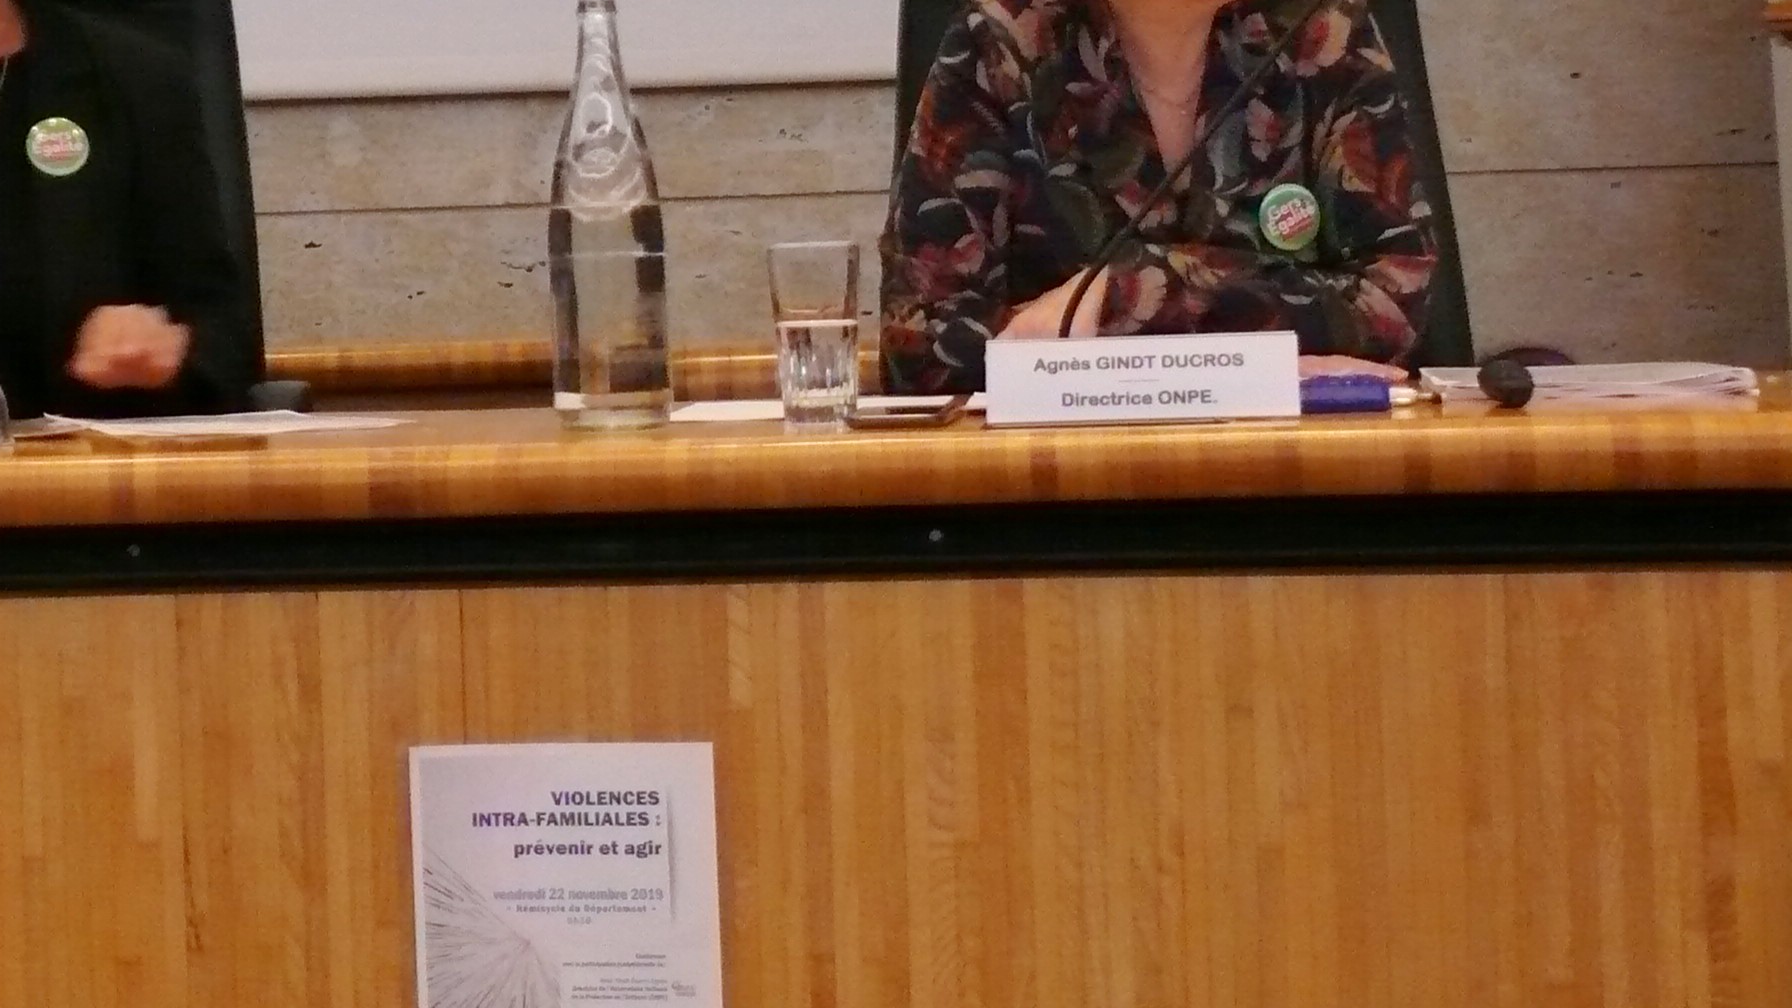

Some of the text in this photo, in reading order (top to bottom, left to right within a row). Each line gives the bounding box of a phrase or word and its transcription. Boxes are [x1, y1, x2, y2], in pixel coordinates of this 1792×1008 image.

[1033, 353, 1244, 374] Agnès GINDT DUCROS
[1061, 389, 1219, 408] Directrice ONPE.
[551, 791, 660, 806] VIOLENCES
[472, 811, 650, 828] INTRA-FAMILIALES
[514, 840, 662, 859] prévenir et agir
[493, 888, 546, 900] vendredi
[549, 888, 565, 899] 22
[568, 888, 628, 900] novembre
